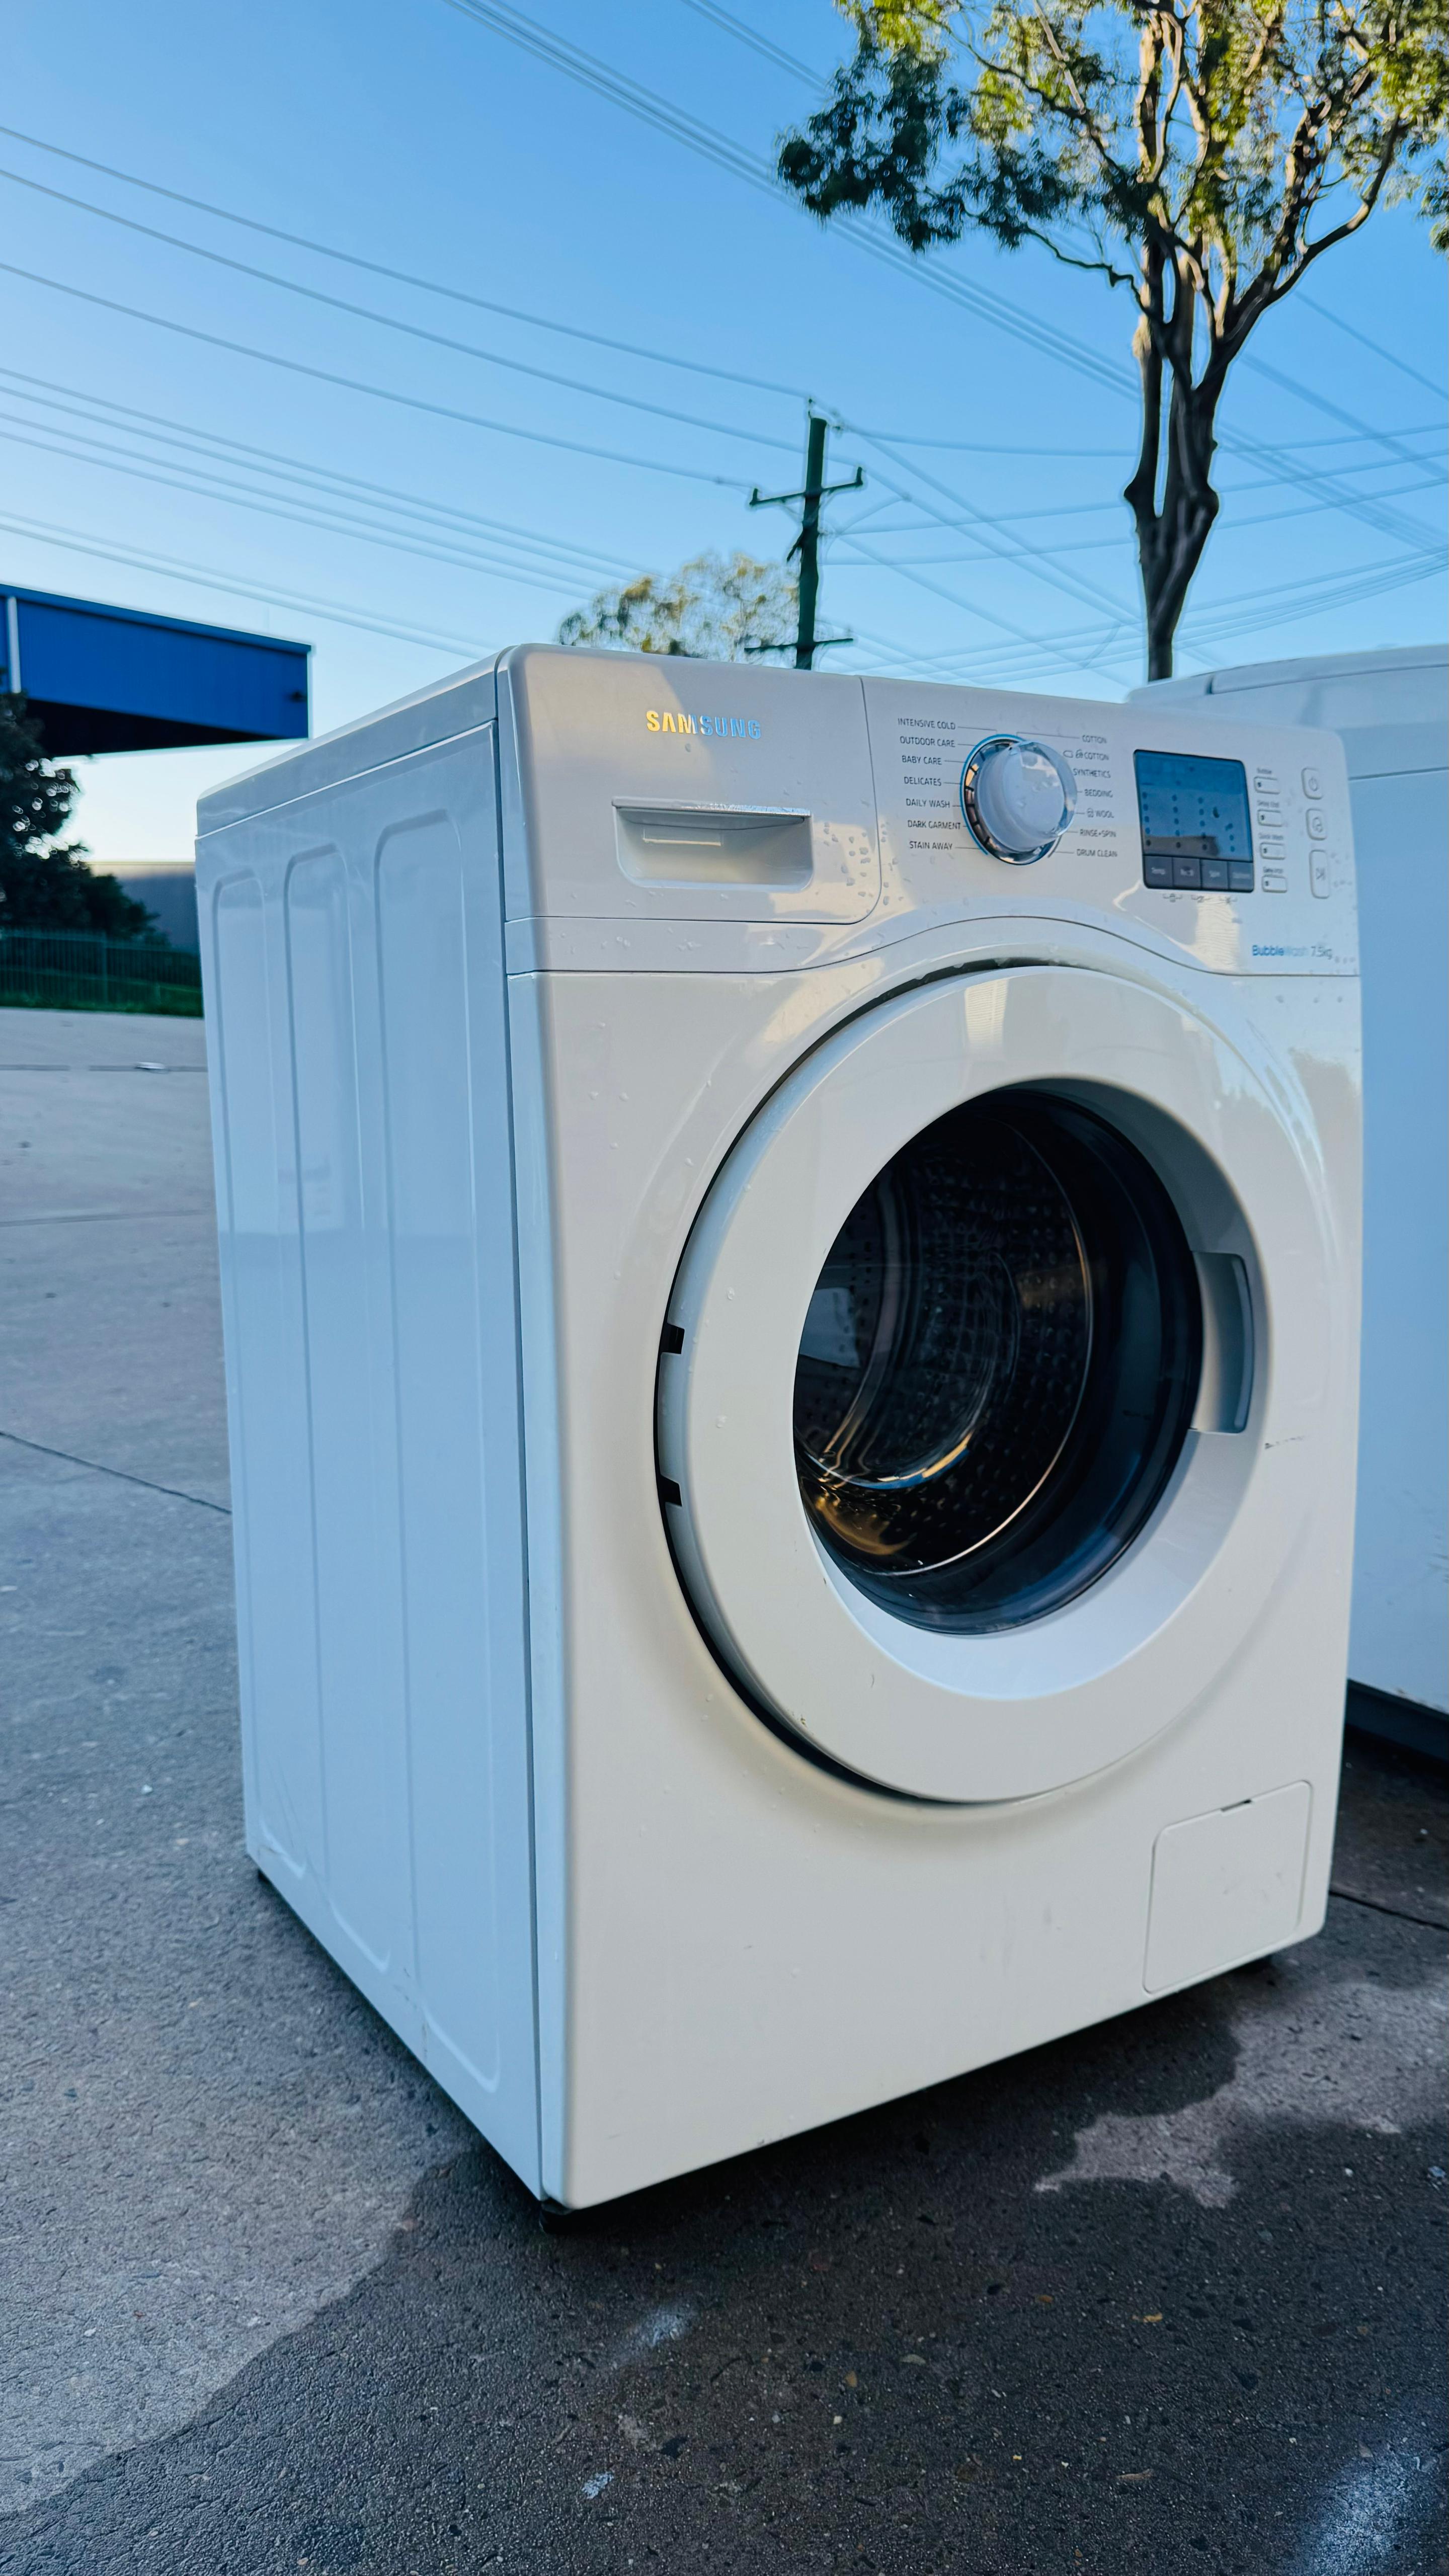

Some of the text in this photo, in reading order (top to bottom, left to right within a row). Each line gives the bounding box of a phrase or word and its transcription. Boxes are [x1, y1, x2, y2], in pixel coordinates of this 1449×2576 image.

[646, 710, 761, 739] SAMSUNG
[898, 717, 956, 730] INTENSIVE COLD
[900, 736, 956, 748] OUTDOOR CARE
[1082, 734, 1107, 744] COTTON
[902, 755, 942, 765] BABY CARE
[1084, 752, 1109, 761] COTTON
[1073, 768, 1111, 778] SYNTHETICS
[904, 776, 942, 786] DELICATES
[1084, 788, 1113, 798] BEDDING
[906, 798, 950, 808] DAILY WASH
[1095, 810, 1115, 819] WOOL
[907, 820, 961, 830] DARK GARMENT
[909, 841, 953, 850] STAIN AWAY
[1077, 848, 1118, 858] DRUM CLEAN
